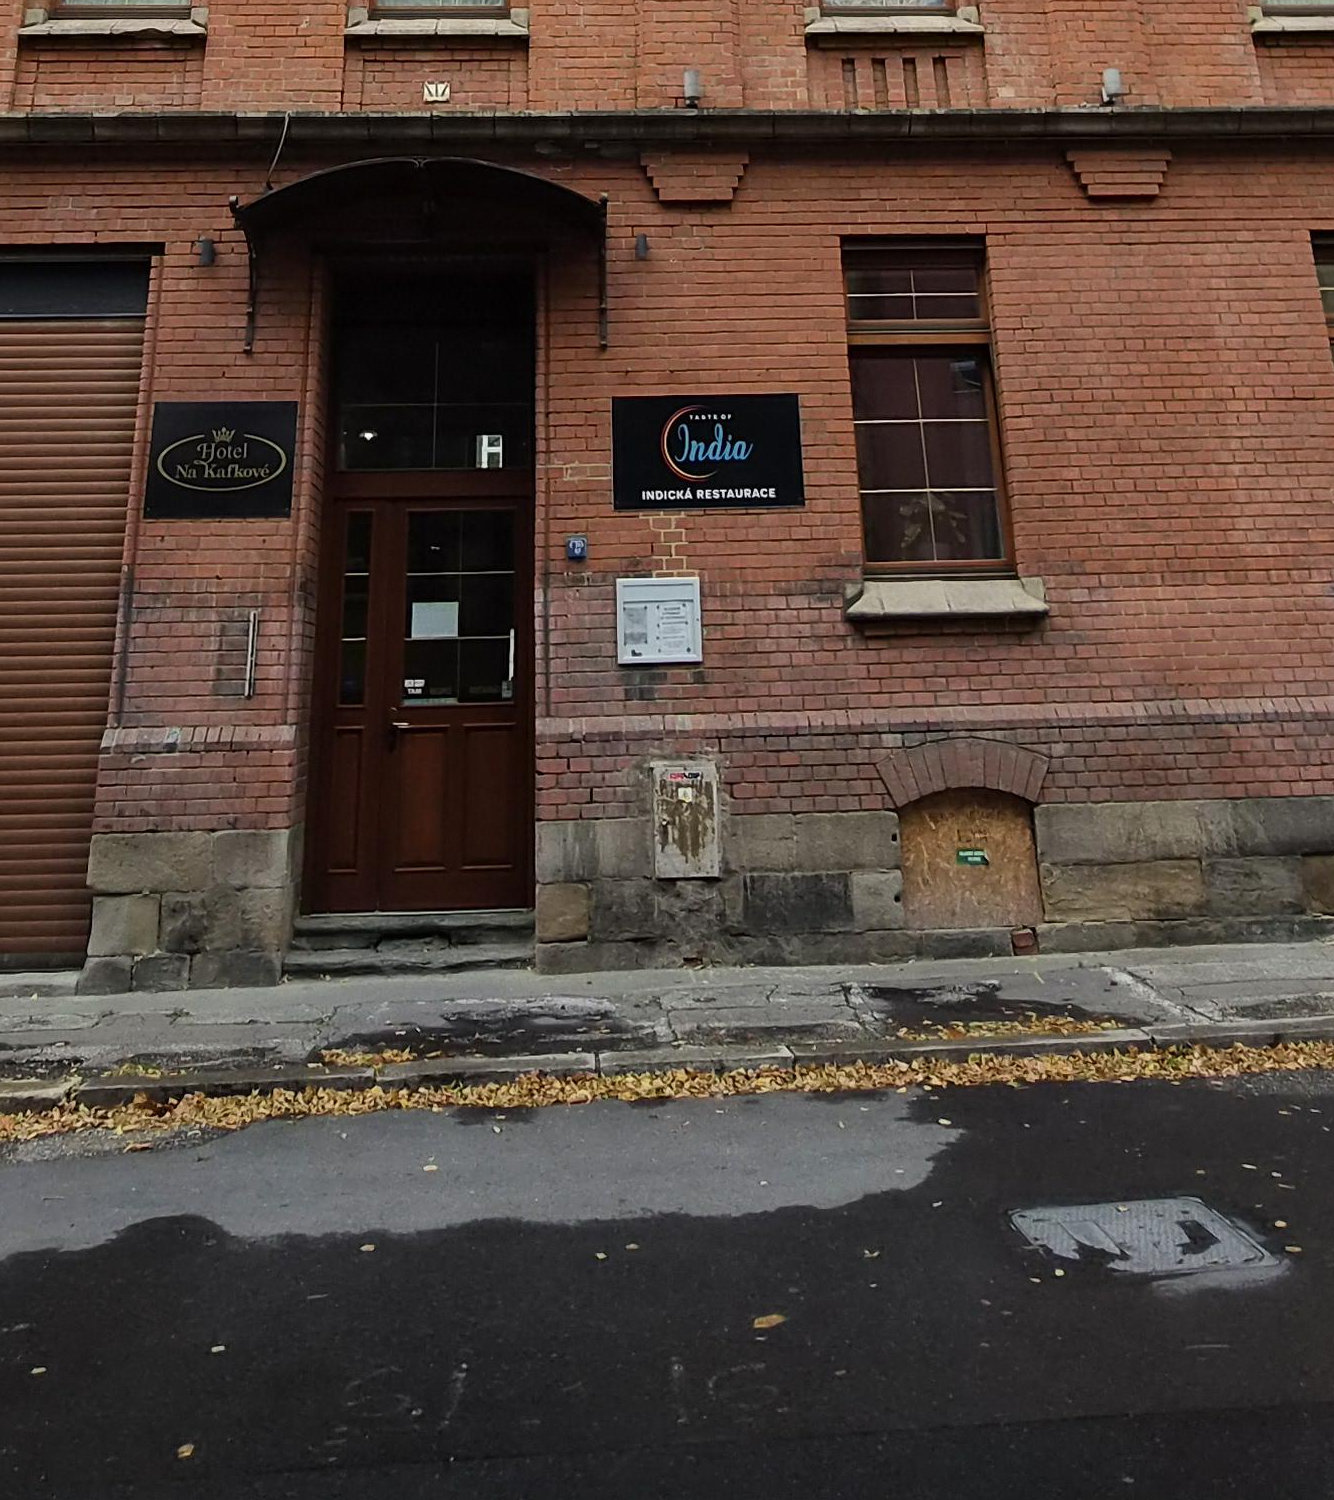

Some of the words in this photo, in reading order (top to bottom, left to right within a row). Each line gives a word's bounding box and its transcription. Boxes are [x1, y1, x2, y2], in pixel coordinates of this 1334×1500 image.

[195, 442, 248, 463] Hotel
[674, 423, 754, 463] India
[175, 464, 197, 479] Na
[203, 462, 270, 479] Kafkové
[641, 487, 693, 501] INDICKÁ
[696, 487, 777, 500] RESTAURACE
